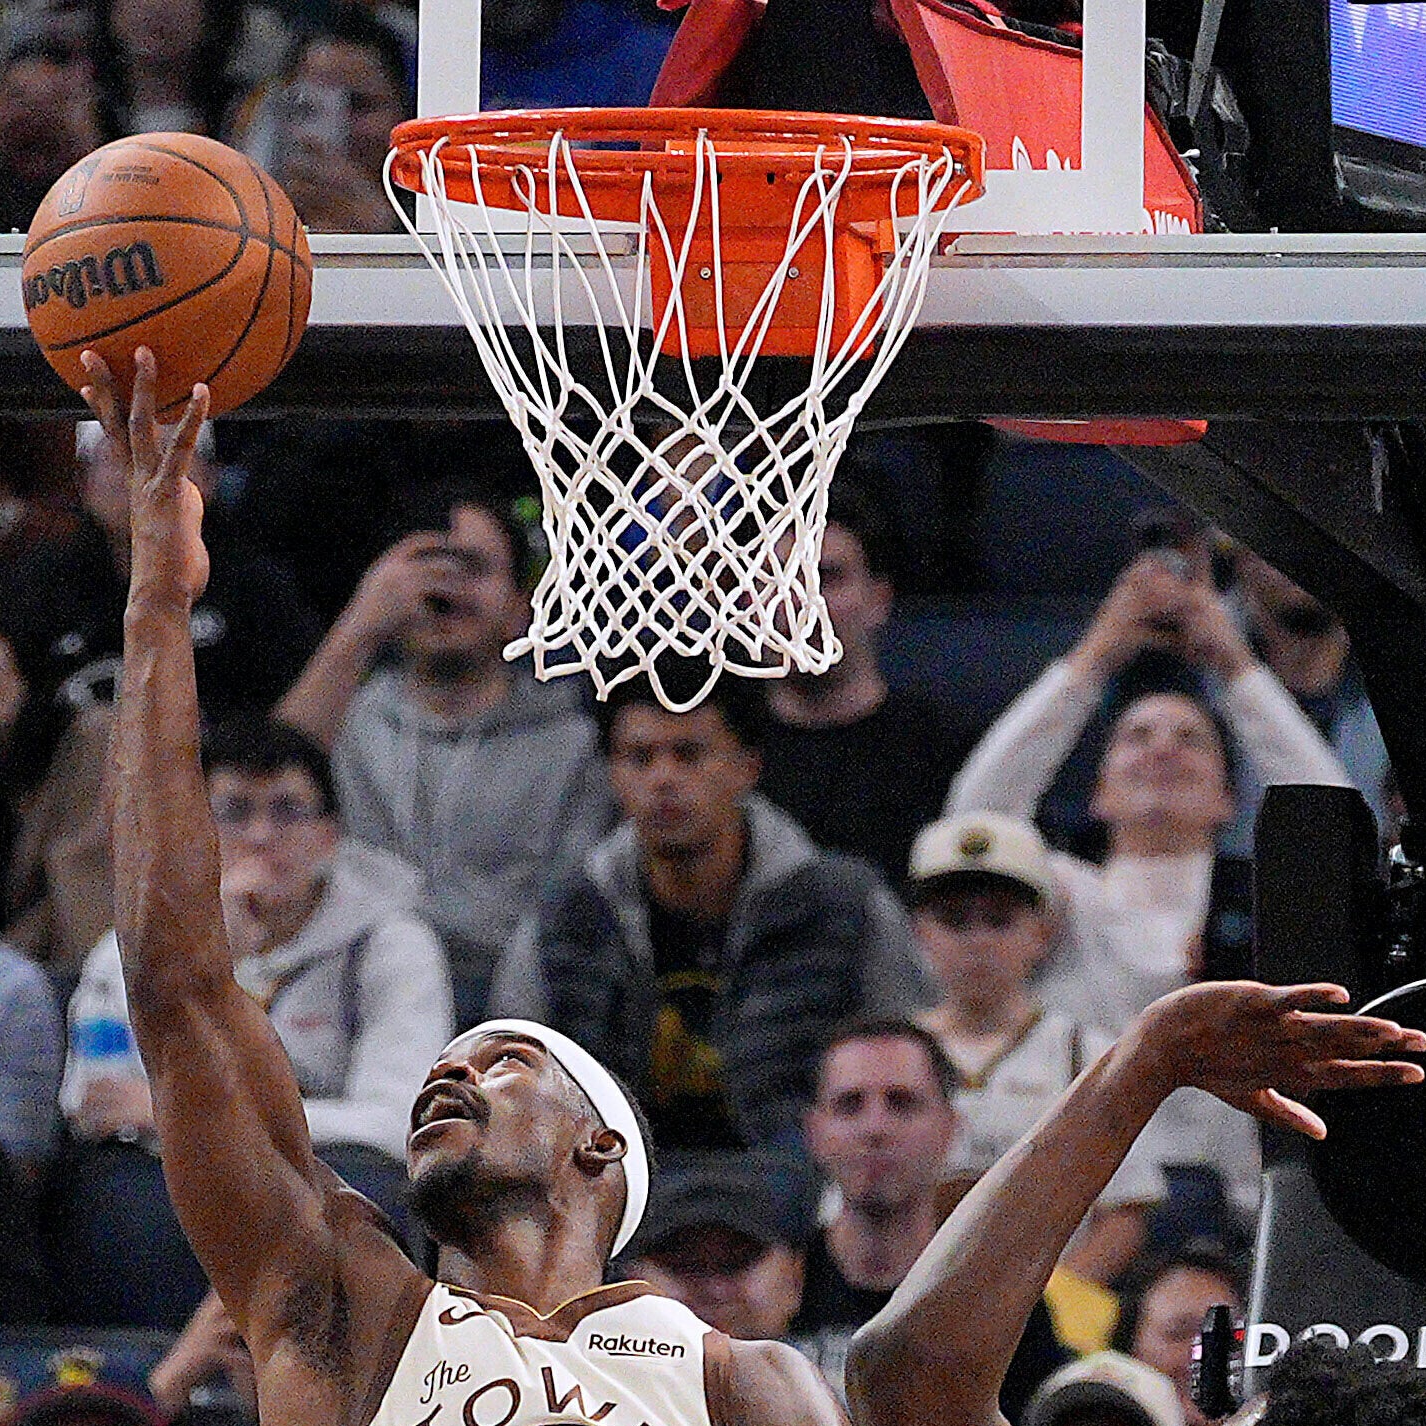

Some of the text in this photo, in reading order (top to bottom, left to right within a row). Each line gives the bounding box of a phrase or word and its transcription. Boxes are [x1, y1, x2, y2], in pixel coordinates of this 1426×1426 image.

[26, 240, 165, 309] Wilson
[588, 1333, 685, 1358] Rakuten
[419, 1360, 471, 1404] The
